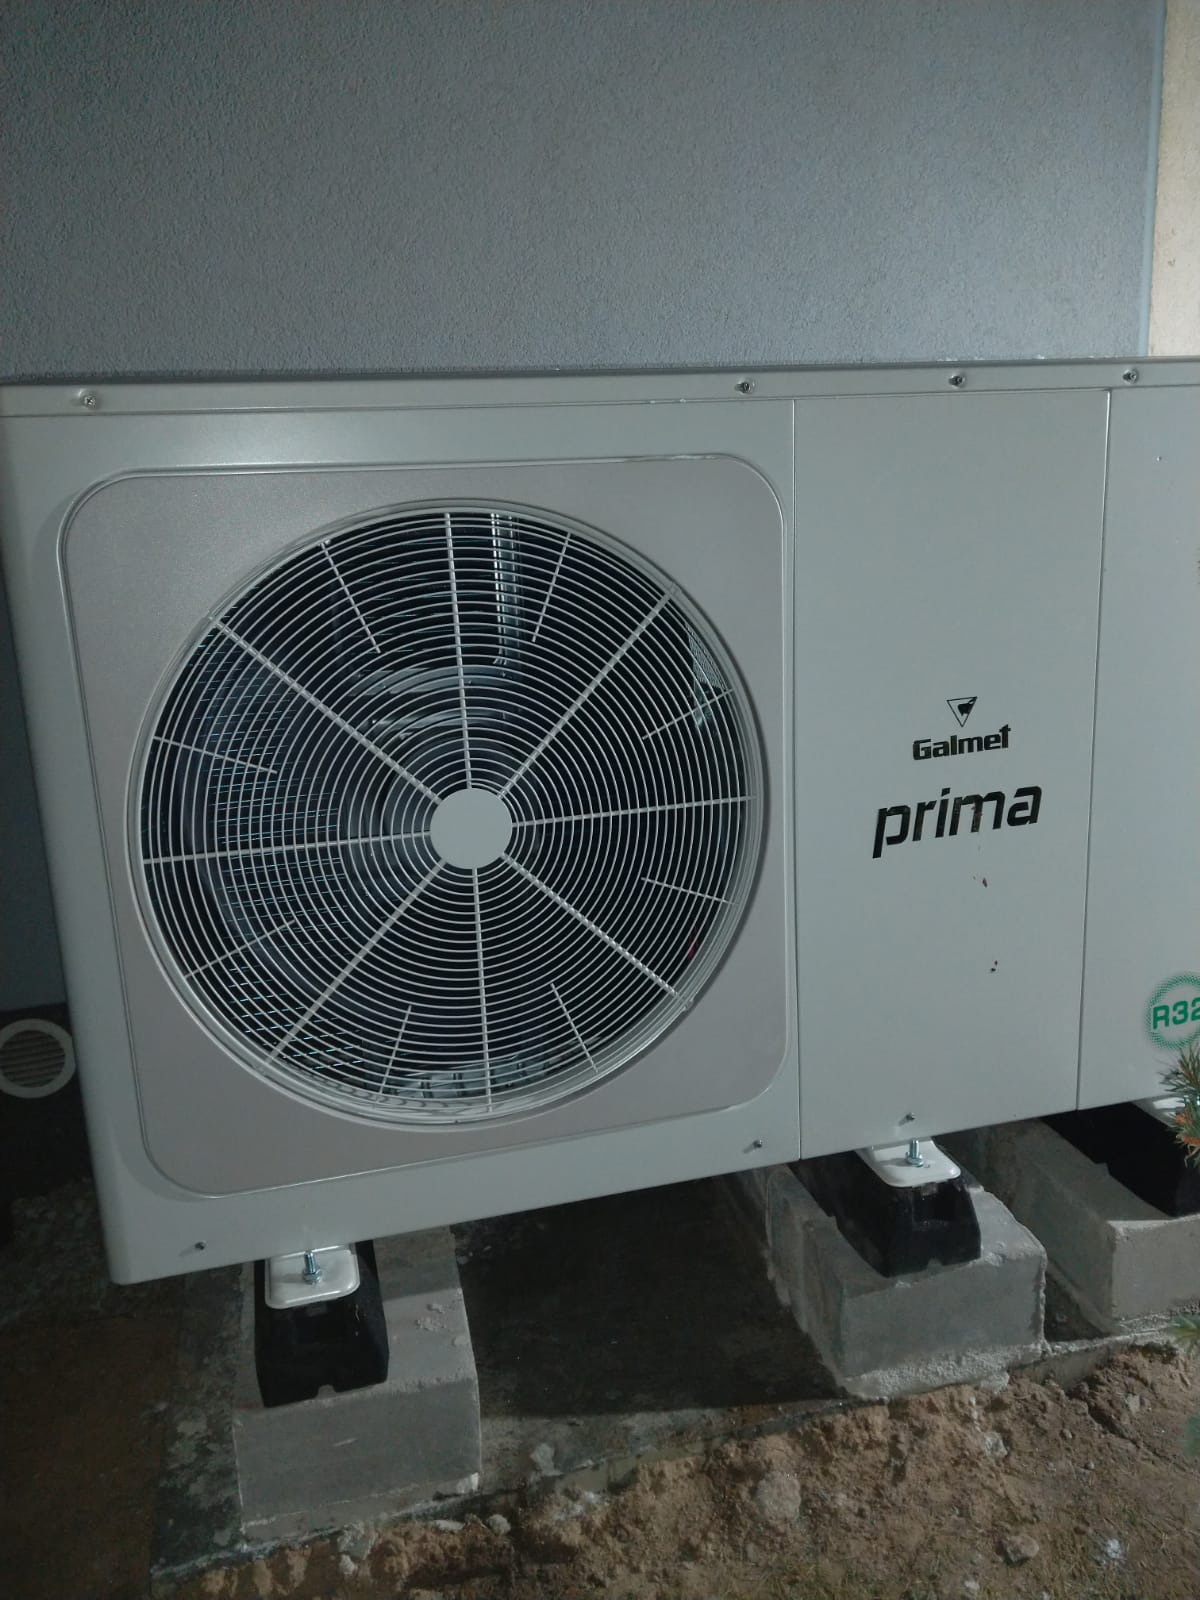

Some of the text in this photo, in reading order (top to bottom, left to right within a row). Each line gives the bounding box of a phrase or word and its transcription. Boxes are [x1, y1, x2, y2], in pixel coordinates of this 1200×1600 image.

[913, 724, 1011, 760] Galmet
[872, 786, 1042, 858] prima
[1153, 997, 1200, 1029] R32
